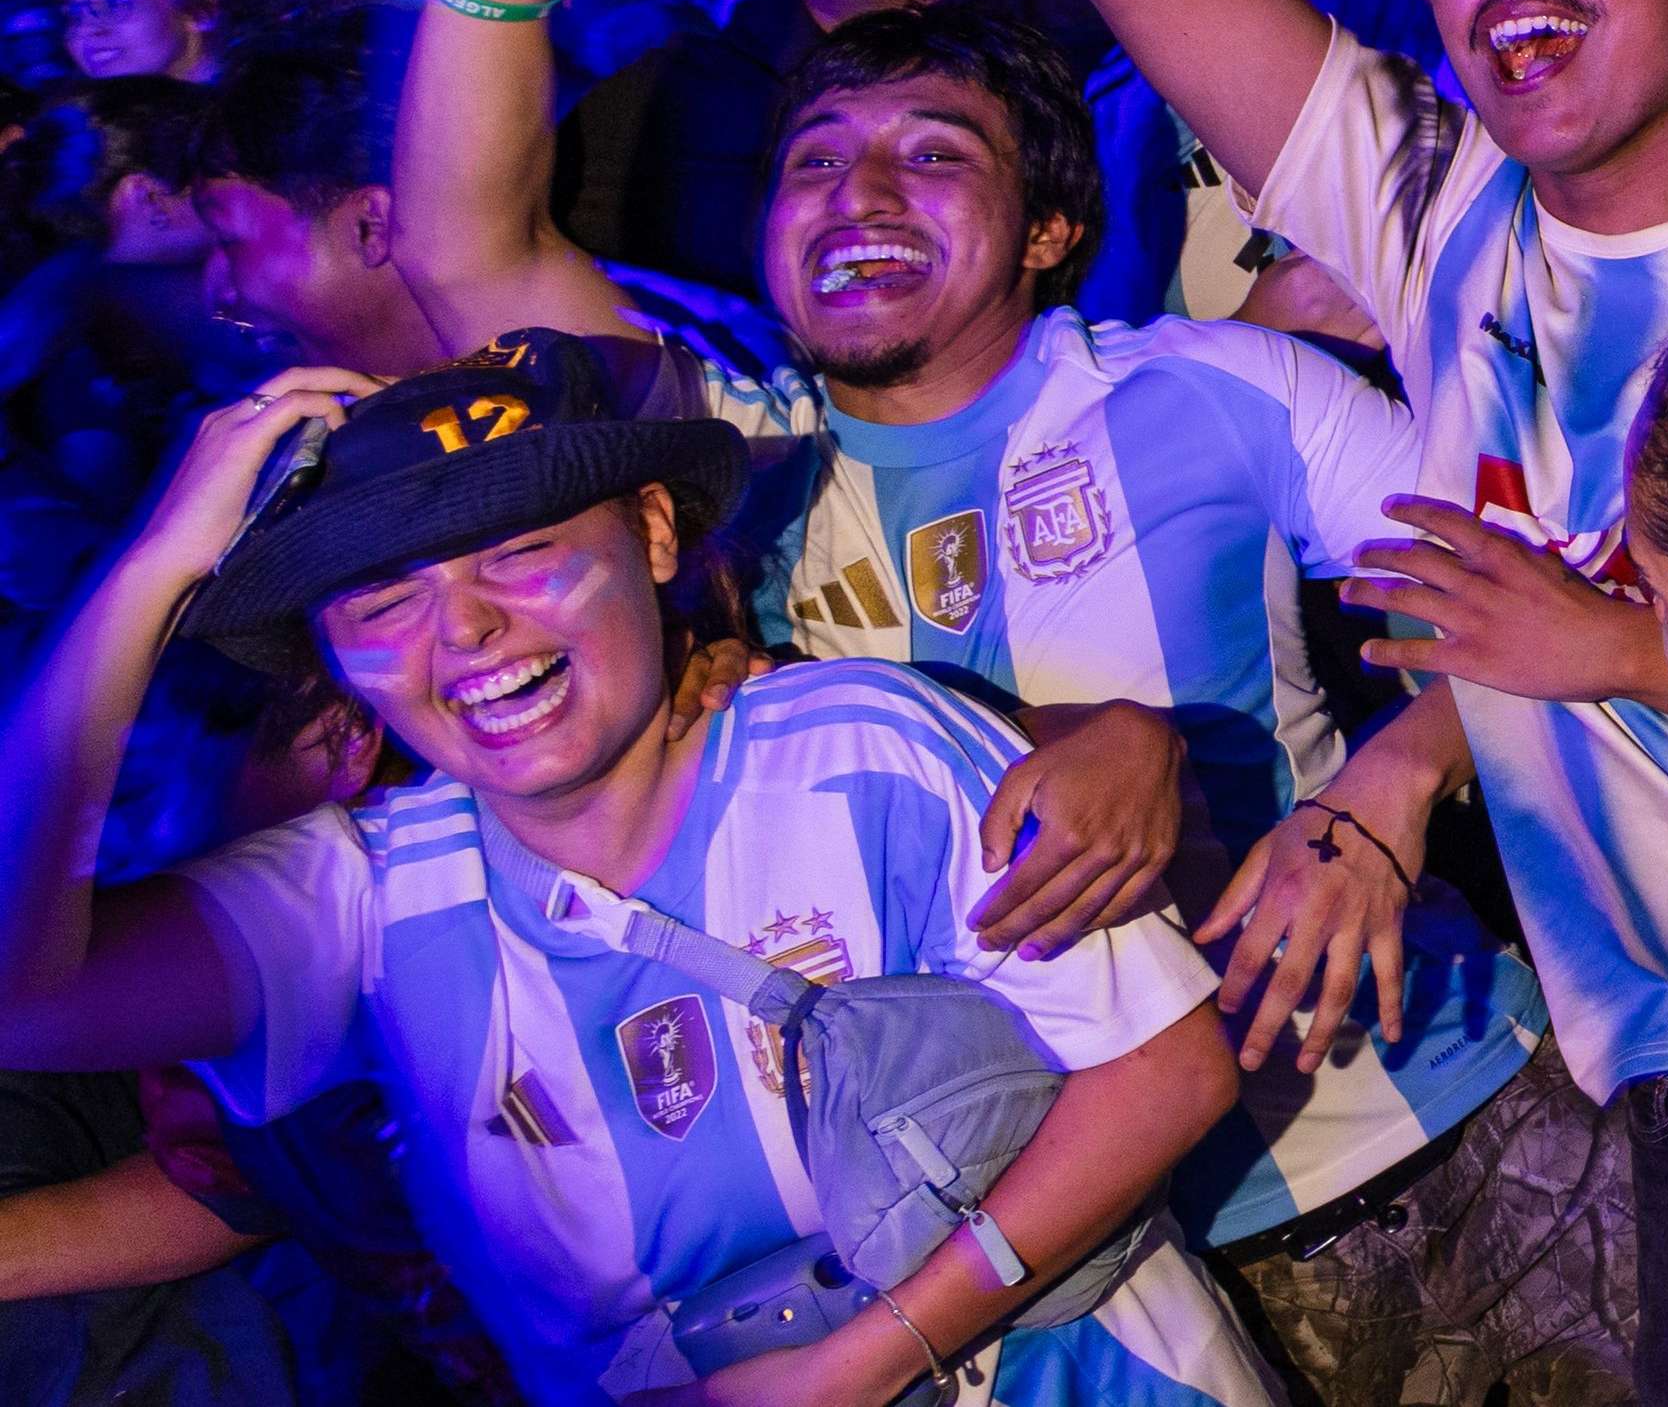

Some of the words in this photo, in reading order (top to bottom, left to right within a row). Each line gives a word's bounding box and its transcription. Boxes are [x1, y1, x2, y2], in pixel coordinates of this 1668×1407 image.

[420, 395, 543, 453] 12
[1032, 495, 1089, 547] AFA
[940, 583, 975, 609] FIFA
[656, 1082, 694, 1110] FIFA
